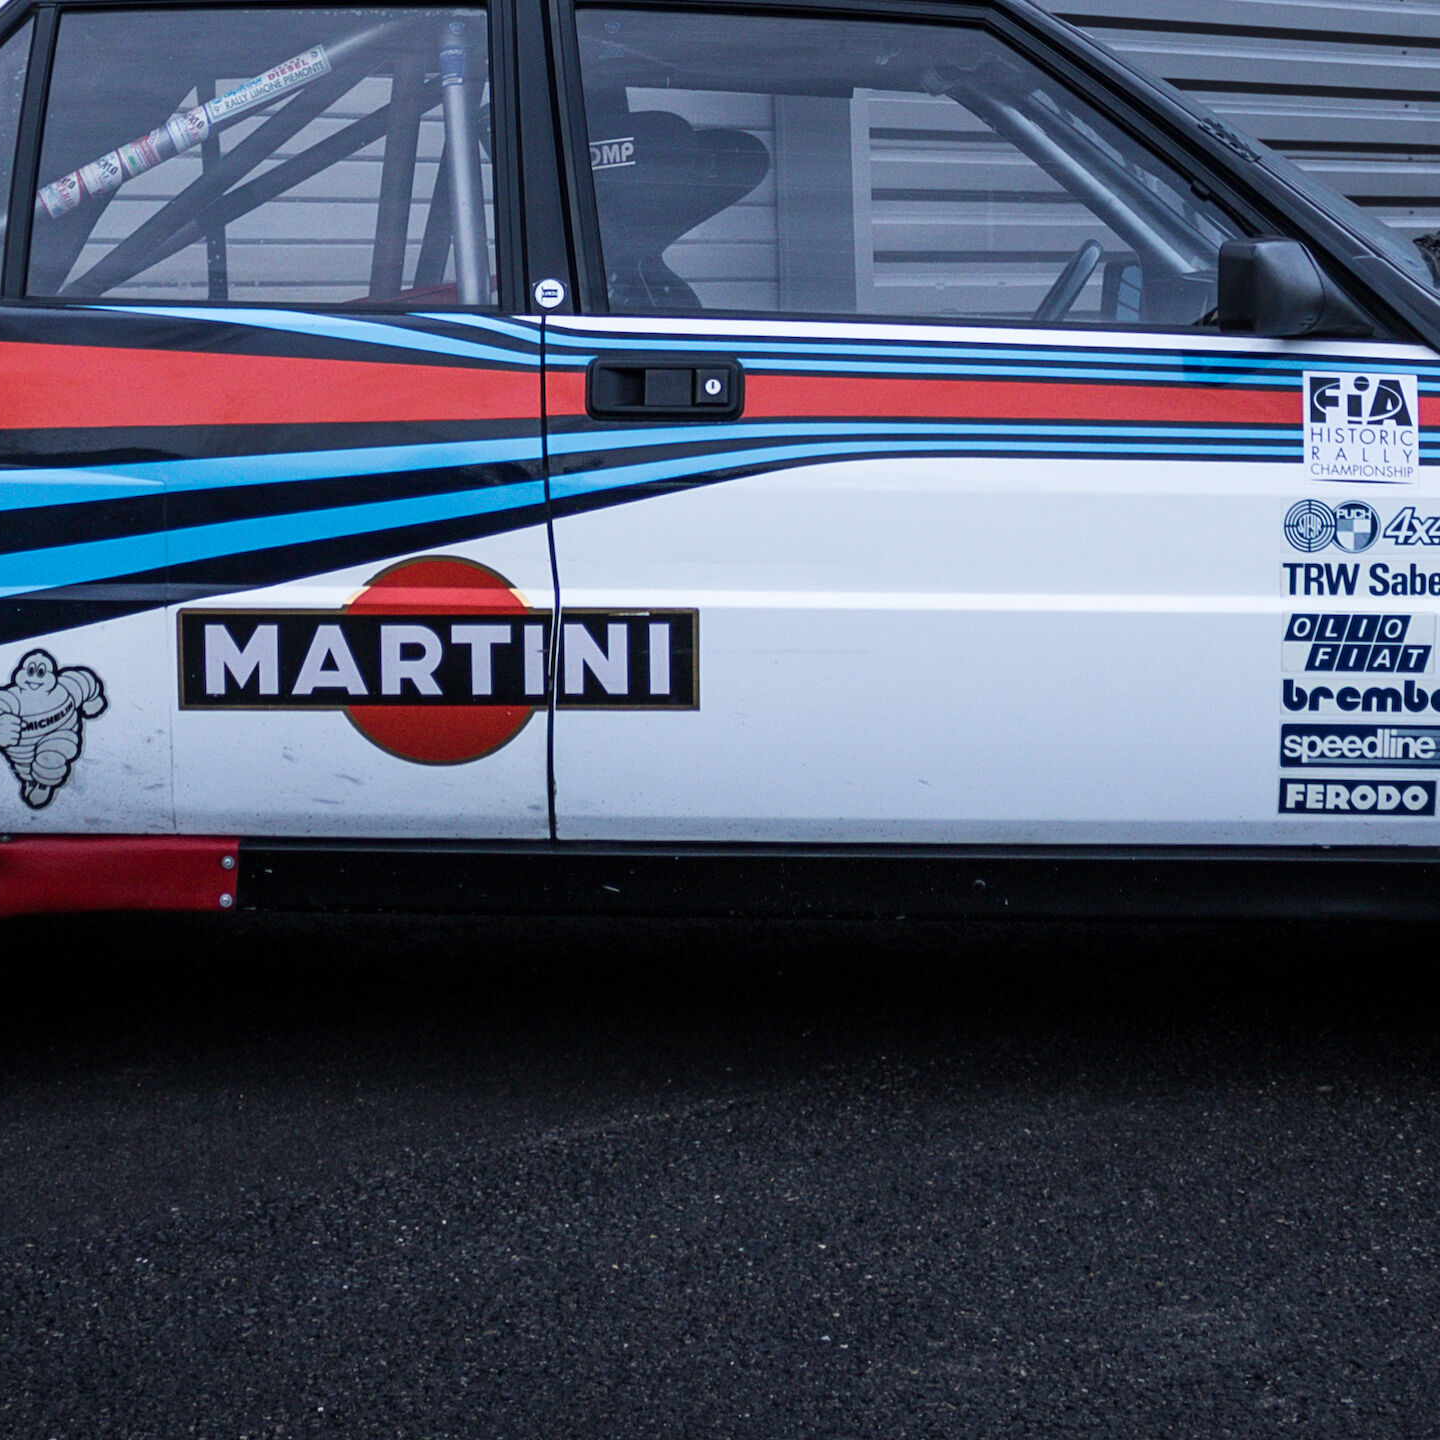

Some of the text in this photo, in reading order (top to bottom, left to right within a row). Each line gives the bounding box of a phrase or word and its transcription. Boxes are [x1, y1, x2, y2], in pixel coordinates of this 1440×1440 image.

[224, 93, 248, 110] RALLY
[249, 79, 283, 101] LIMONE
[282, 60, 327, 84] PIEMONTE
[1310, 427, 1414, 446] HISTORIC
[1311, 446, 1413, 464] RALLY
[1310, 463, 1414, 478] CHAMPIONSHIP
[1336, 509, 1372, 520] PUCH
[1282, 562, 1361, 597] TRW
[1292, 616, 1404, 640] OLIO
[203, 622, 672, 697] MARTINI
[1313, 647, 1425, 669] FIAT
[21, 701, 74, 732] MICHELIN
[1283, 728, 1437, 763] speedline
[1285, 783, 1429, 811] FERODO
